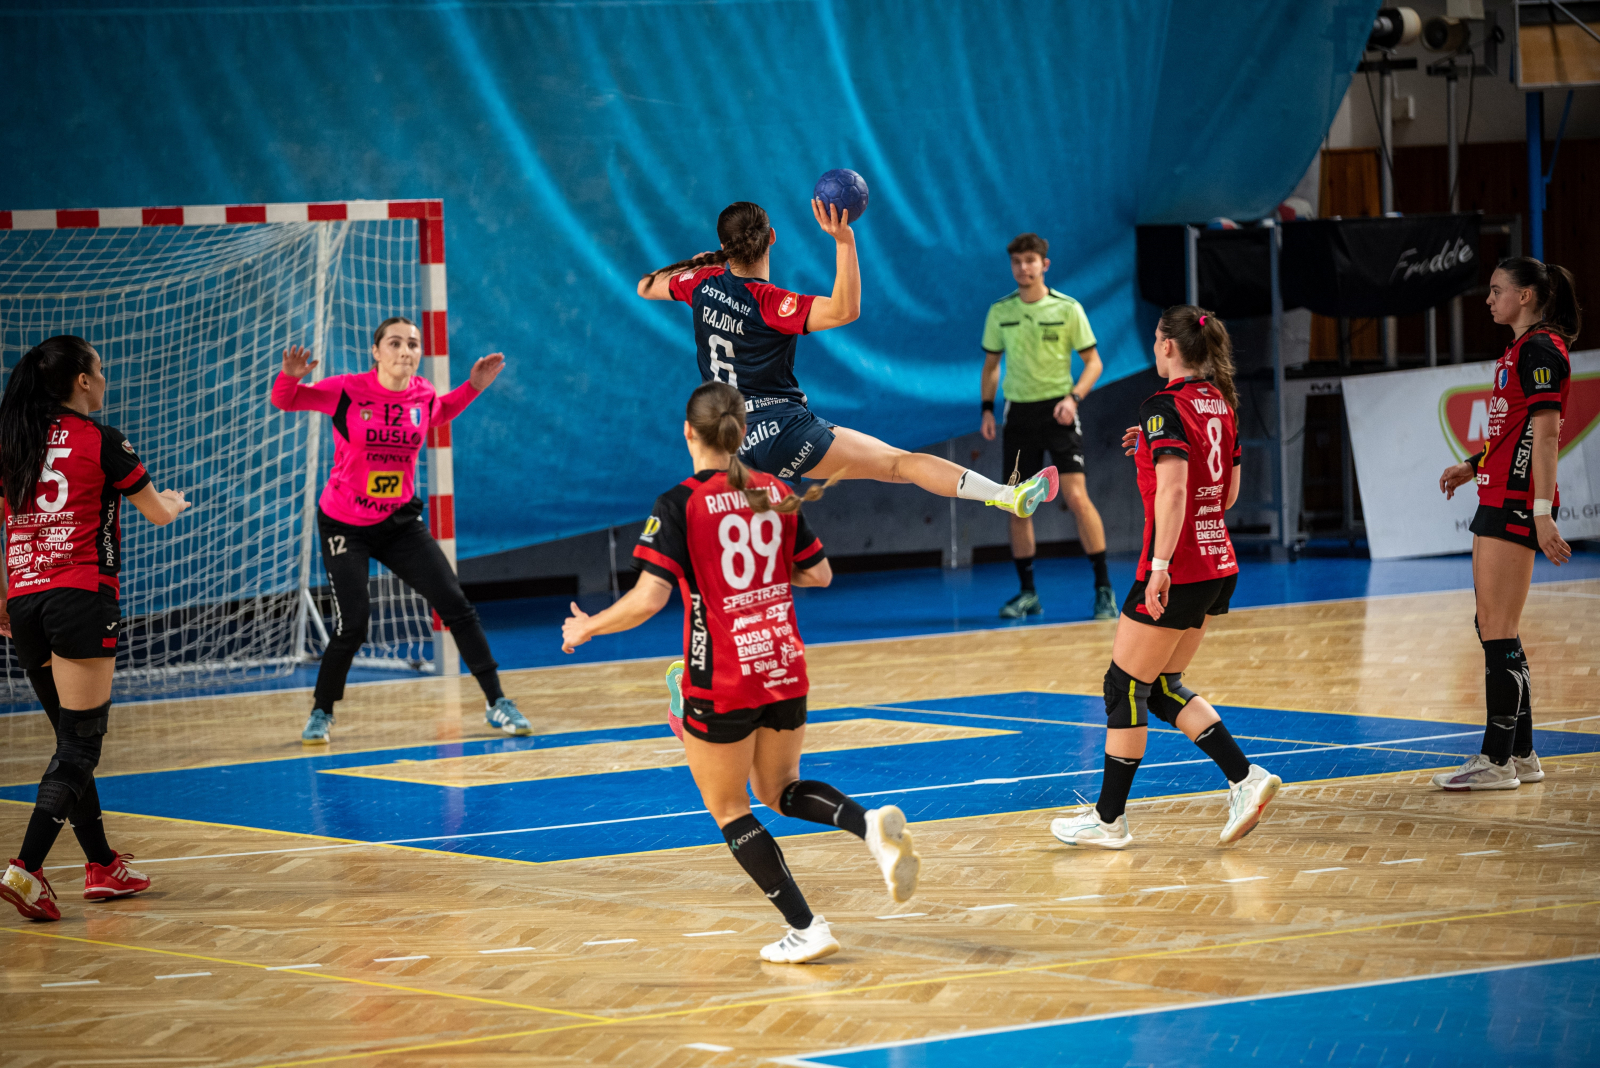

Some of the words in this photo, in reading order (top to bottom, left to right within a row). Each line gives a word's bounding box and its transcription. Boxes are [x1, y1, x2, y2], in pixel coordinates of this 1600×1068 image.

[708, 334, 738, 389] 6
[383, 403, 404, 427] 12
[1207, 417, 1223, 482] 8
[36, 447, 73, 513] 5
[371, 475, 399, 494] SPP
[328, 535, 347, 556] 12
[1196, 529, 1226, 540] ENERGY
[717, 509, 783, 590] 89
[737, 640, 774, 658] ENERGY
[753, 658, 778, 674] Silvia
